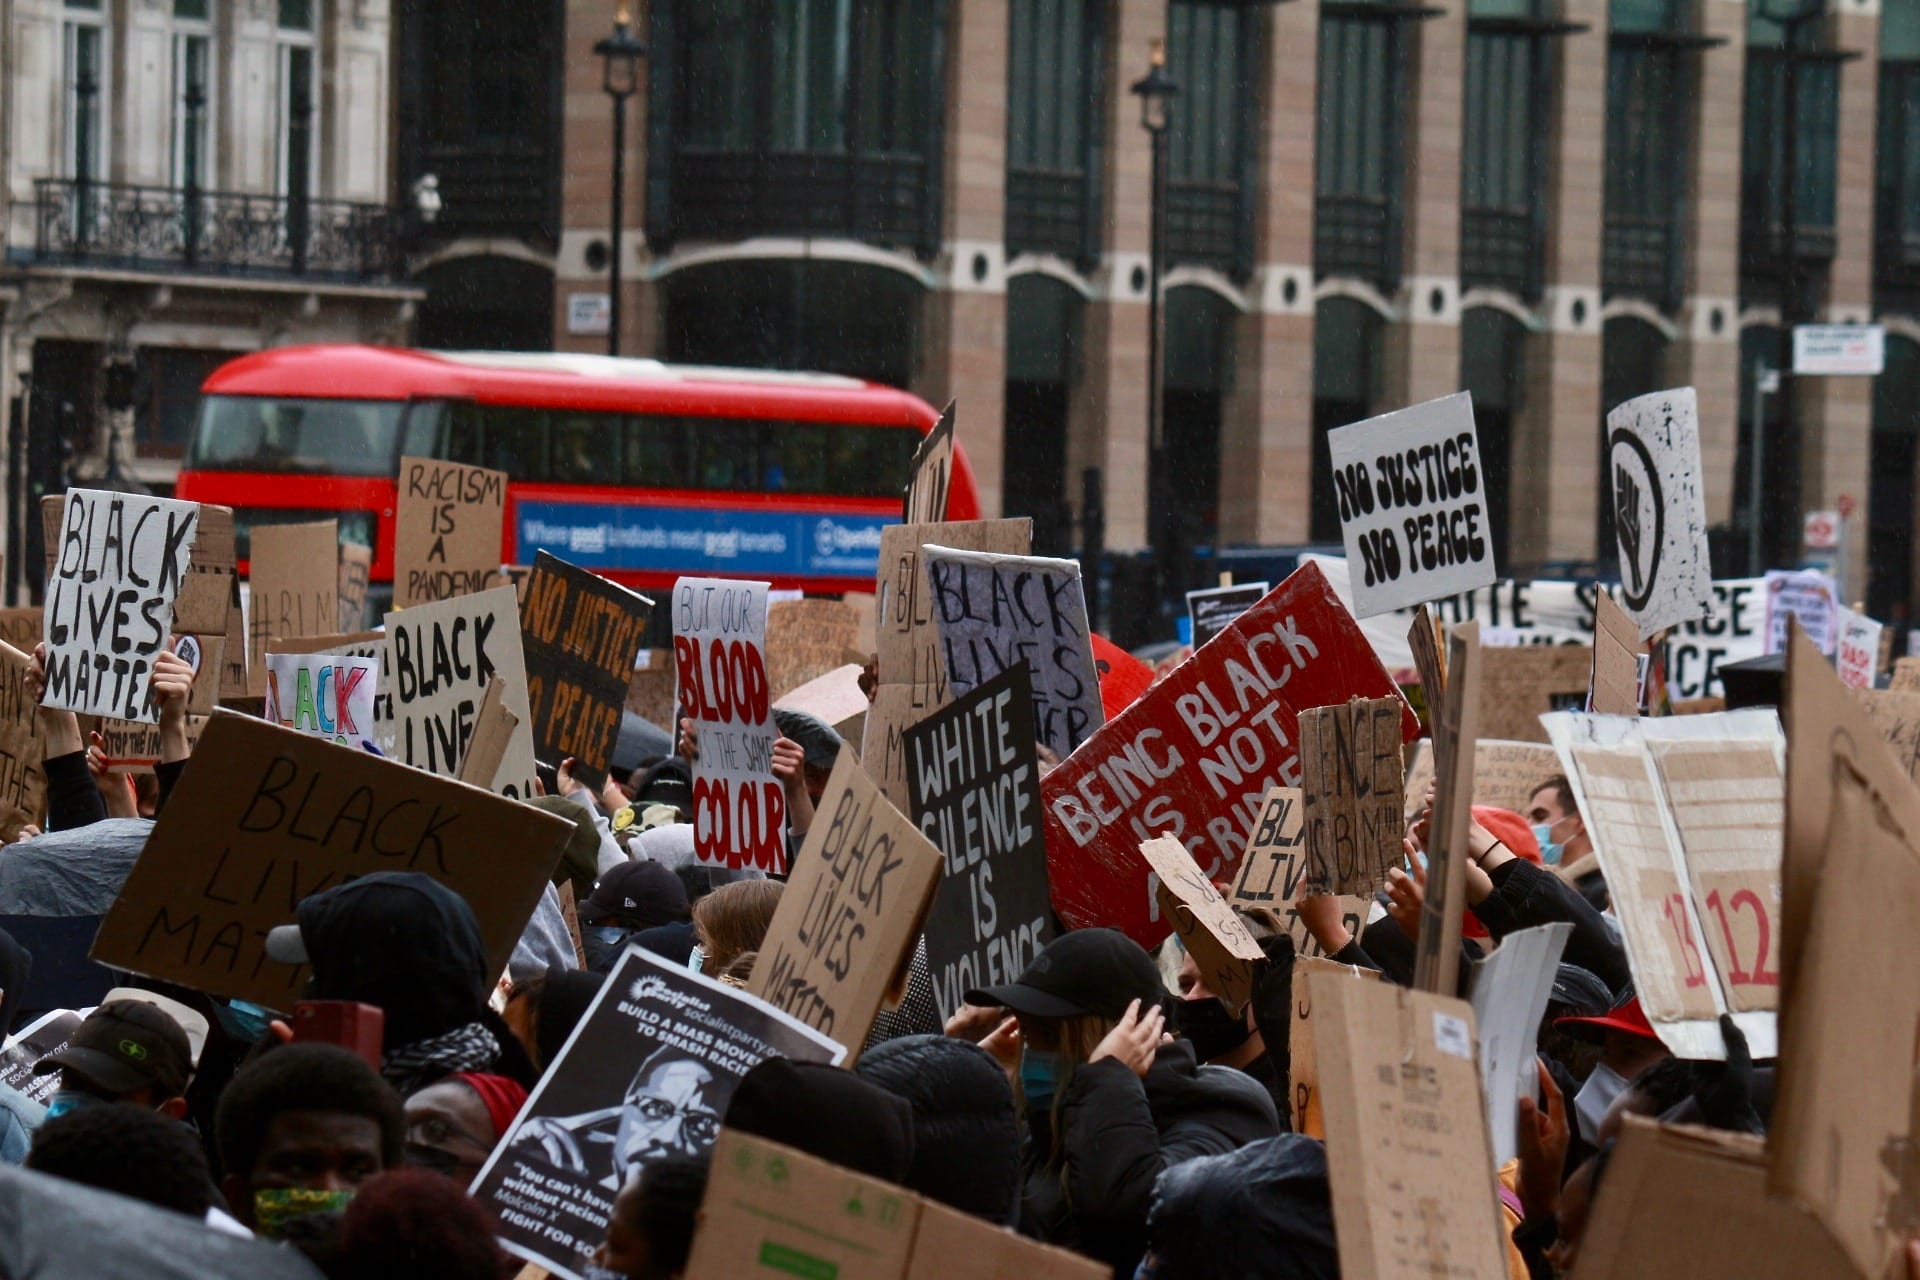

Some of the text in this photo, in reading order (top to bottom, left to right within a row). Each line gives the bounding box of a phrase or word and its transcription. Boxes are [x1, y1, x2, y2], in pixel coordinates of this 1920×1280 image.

[409, 464, 500, 506] RACISM
[1335, 432, 1477, 522] NO JUSTICE
[59, 493, 196, 594] BLACK
[428, 536, 446, 563] A
[431, 504, 455, 534] IS
[1358, 503, 1485, 587] NO PEACE
[49, 579, 164, 657] LIVES
[522, 569, 567, 644] NO
[563, 589, 646, 682] JUSTICE
[680, 586, 753, 633] BUT OUR
[931, 559, 1082, 638] BLACK
[395, 612, 495, 703] BLACK
[674, 636, 769, 726] BLOOD
[1174, 614, 1320, 748] BLACK
[104, 728, 128, 757] STOP
[128, 731, 147, 756] THE
[405, 699, 475, 774] LIVE
[526, 672, 618, 771] O PEACE
[714, 731, 737, 770] THE
[914, 687, 1017, 806] WHITE
[1198, 700, 1289, 799] NOT
[239, 755, 461, 875] BLACK
[693, 776, 786, 874] COLOUR
[1053, 728, 1185, 848] BEING
[1130, 794, 1185, 842] IS
[821, 788, 903, 916] BLACK
[969, 860, 998, 944] IS
[616, 1001, 660, 1024] BUILD
[660, 1017, 672, 1031] A
[672, 1021, 714, 1046] MASS
[636, 1023, 751, 1077] TO SMASH RACIS
[494, 1189, 561, 1222] Malcolm X
[500, 1208, 546, 1233] FIGHT
[544, 1225, 574, 1247] FOR
[502, 1176, 608, 1228] without racism
[545, 1177, 582, 1199] can't
